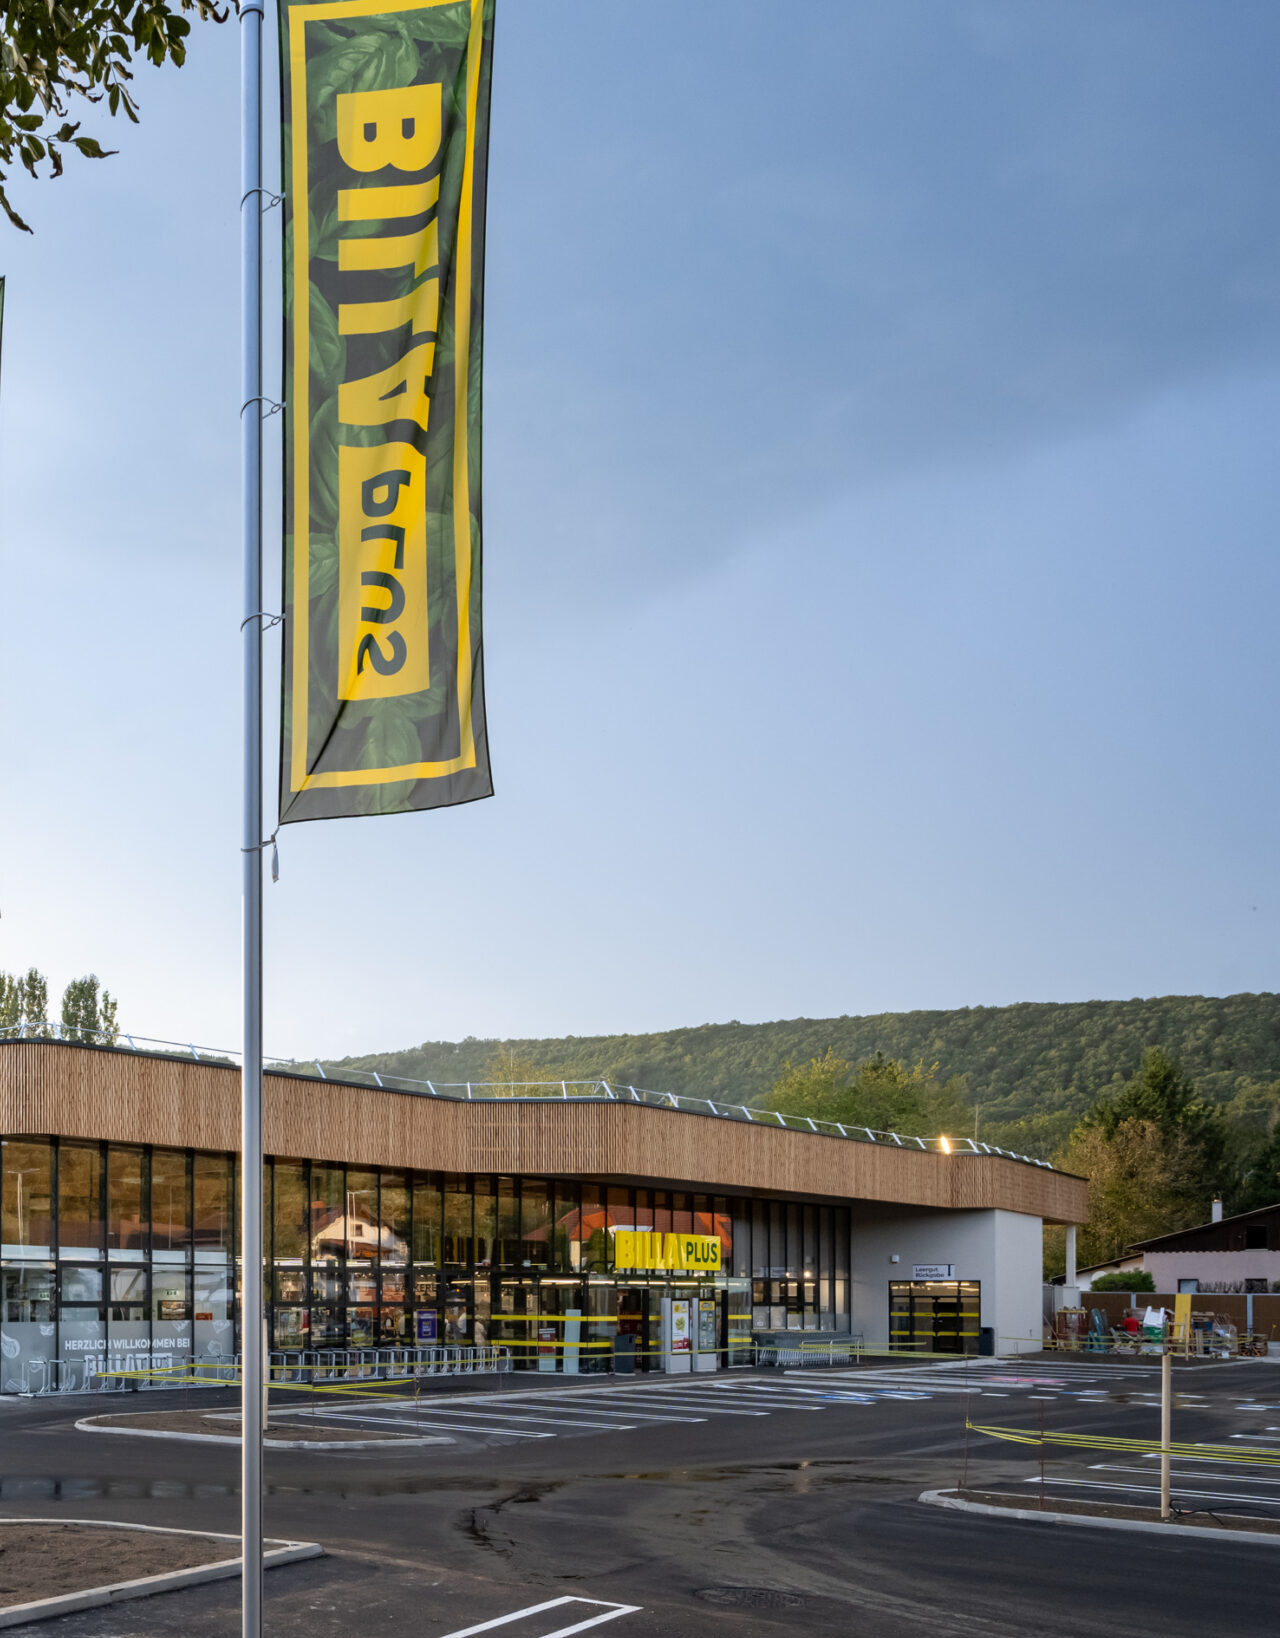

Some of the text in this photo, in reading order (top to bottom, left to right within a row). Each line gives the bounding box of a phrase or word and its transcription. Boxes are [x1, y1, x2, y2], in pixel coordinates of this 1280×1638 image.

[615, 1230, 718, 1270] BILLA PLUS
[65, 1337, 190, 1350] HERZLICH WILLKOMMEN BEI
